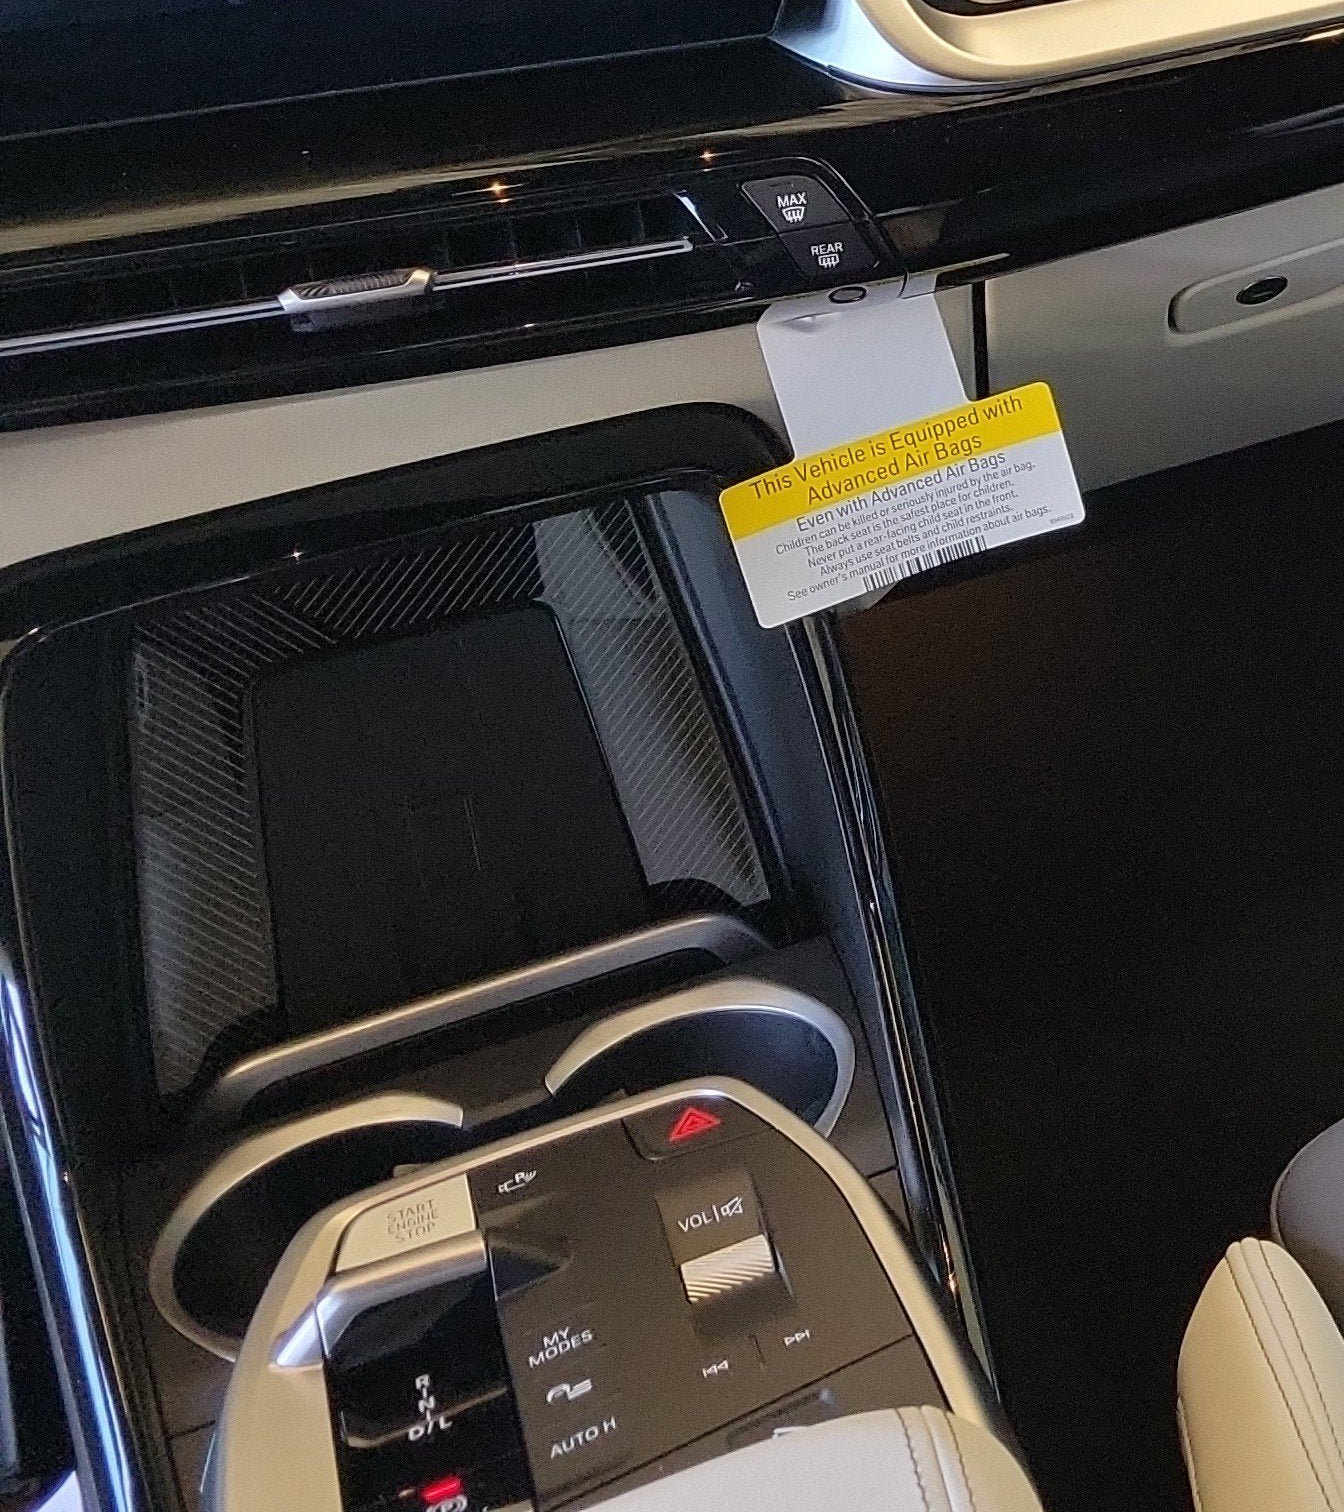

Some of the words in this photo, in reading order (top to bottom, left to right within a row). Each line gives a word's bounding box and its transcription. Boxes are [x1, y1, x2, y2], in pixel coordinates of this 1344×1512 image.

[776, 191, 808, 209] MAX
[810, 241, 844, 257] REAR
[748, 473, 793, 500] This
[793, 448, 866, 483] Vehicle
[868, 440, 887, 458] is
[889, 407, 980, 451] Equipped
[982, 394, 1023, 421] with
[796, 510, 835, 532] Even
[835, 496, 868, 518] with
[871, 469, 943, 506] Advanced
[946, 463, 965, 481] Air
[967, 452, 1006, 473] Bags
[808, 457, 900, 506] Advanced
[905, 449, 929, 472] Air
[933, 435, 982, 461] Bags
[775, 533, 818, 555] Children
[818, 526, 837, 539] can
[850, 509, 880, 528] killed
[890, 491, 934, 514] seriously
[934, 478, 969, 499] injured
[982, 471, 999, 483] the
[1000, 466, 1012, 478] air
[1013, 461, 1036, 473] bag.
[803, 544, 825, 557] The
[824, 533, 850, 550] back
[850, 525, 872, 541] seat
[881, 517, 899, 529] the
[899, 504, 930, 523] safest
[930, 497, 957, 515] place
[957, 492, 971, 503] for
[973, 479, 1015, 498] children.
[807, 553, 833, 568] Never
[832, 544, 856, 560] put
[863, 522, 918, 549] rear-facing
[917, 513, 942, 529] child
[941, 506, 964, 521] seat
[974, 498, 991, 510] the
[991, 489, 1019, 505] front.
[786, 588, 808, 602] See
[809, 573, 848, 594] owner's
[848, 557, 886, 579] manual
[885, 553, 899, 565] for
[900, 544, 926, 560] more
[926, 525, 982, 550] information
[982, 515, 1012, 532] about
[1011, 512, 1024, 523] air
[1024, 505, 1052, 519] bags.
[820, 558, 855, 577] Always
[854, 551, 874, 564] use
[873, 541, 897, 557] seat
[895, 534, 921, 549] belts
[922, 525, 941, 540] and
[941, 517, 965, 533] child
[965, 503, 1014, 525] restraints.
[386, 1198, 436, 1223] START
[387, 1210, 439, 1235] ENGINE
[394, 1221, 436, 1242] STOP
[677, 1208, 714, 1233] VOL
[528, 1329, 594, 1369] MODES
[543, 1326, 570, 1349] MY
[550, 1426, 599, 1459] AUTO
[603, 1416, 617, 1435] H
